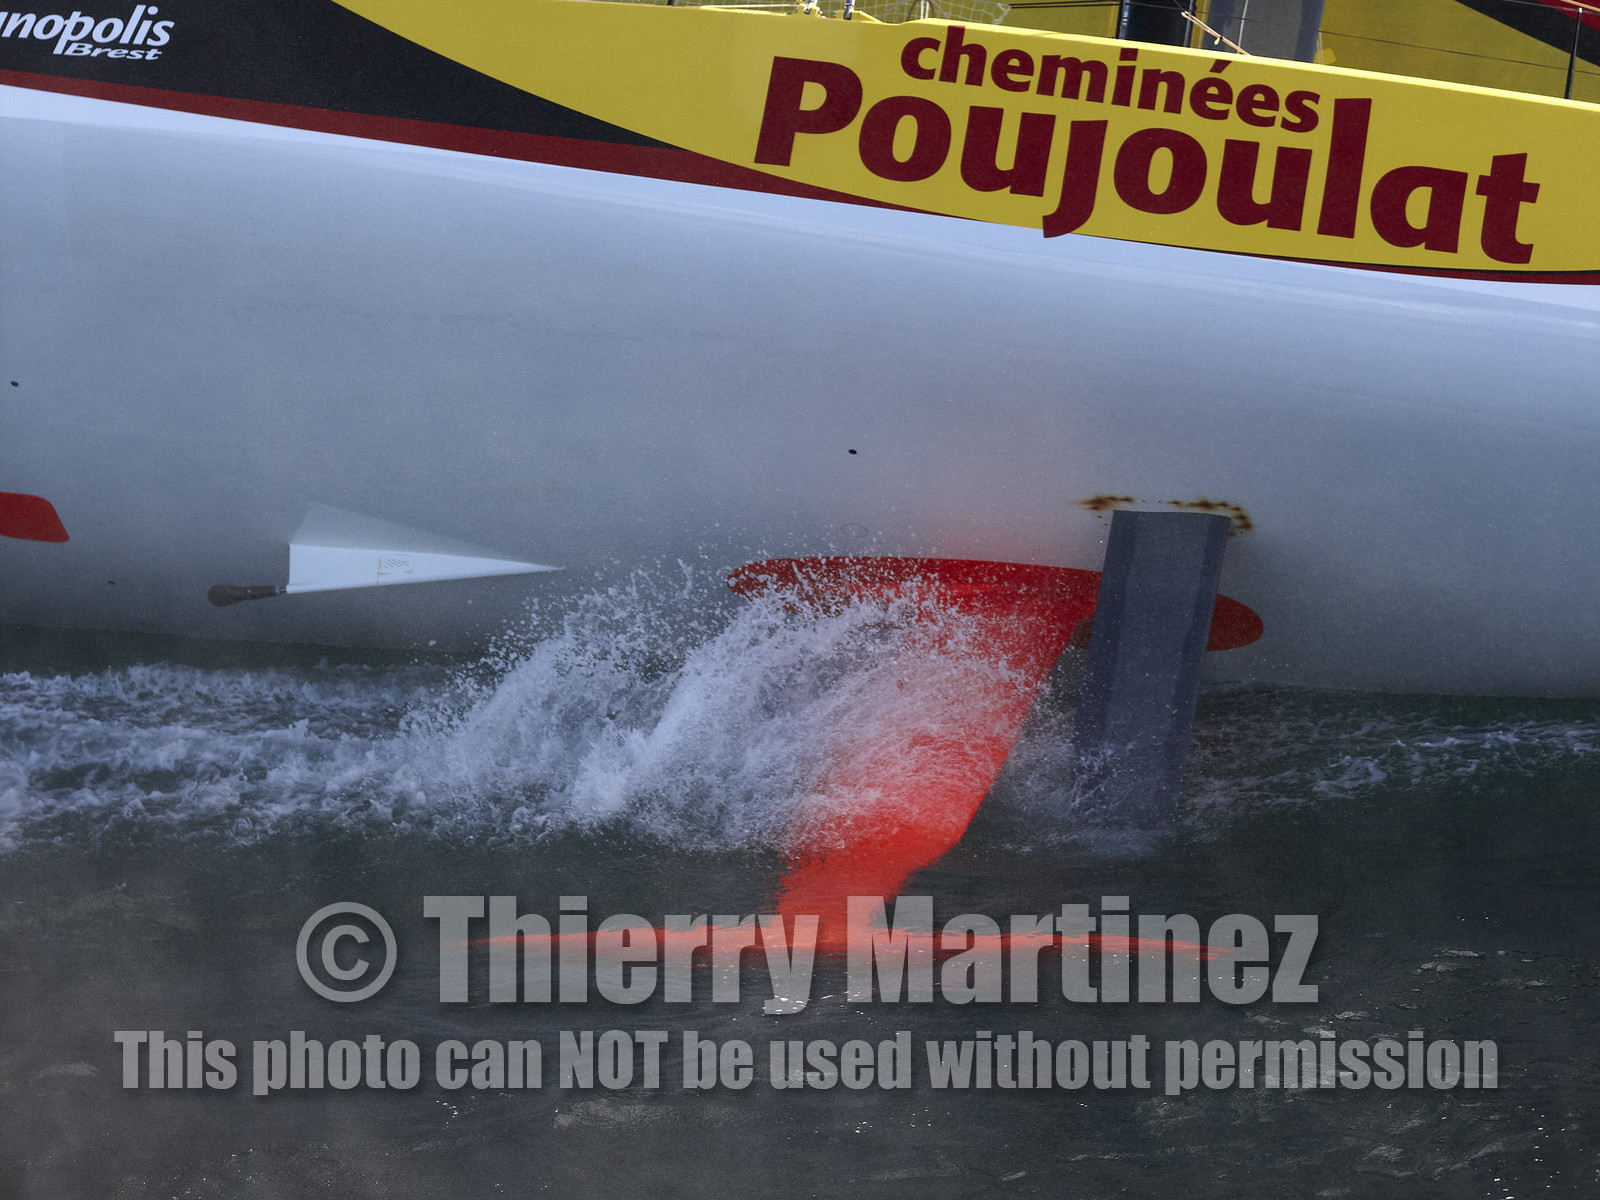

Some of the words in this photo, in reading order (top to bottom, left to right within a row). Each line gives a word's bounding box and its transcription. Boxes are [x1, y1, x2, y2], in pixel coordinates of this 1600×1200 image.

[64, 43, 163, 60] Brest
[900, 25, 1320, 133] cheminées
[753, 56, 1540, 264] Poujoulat
